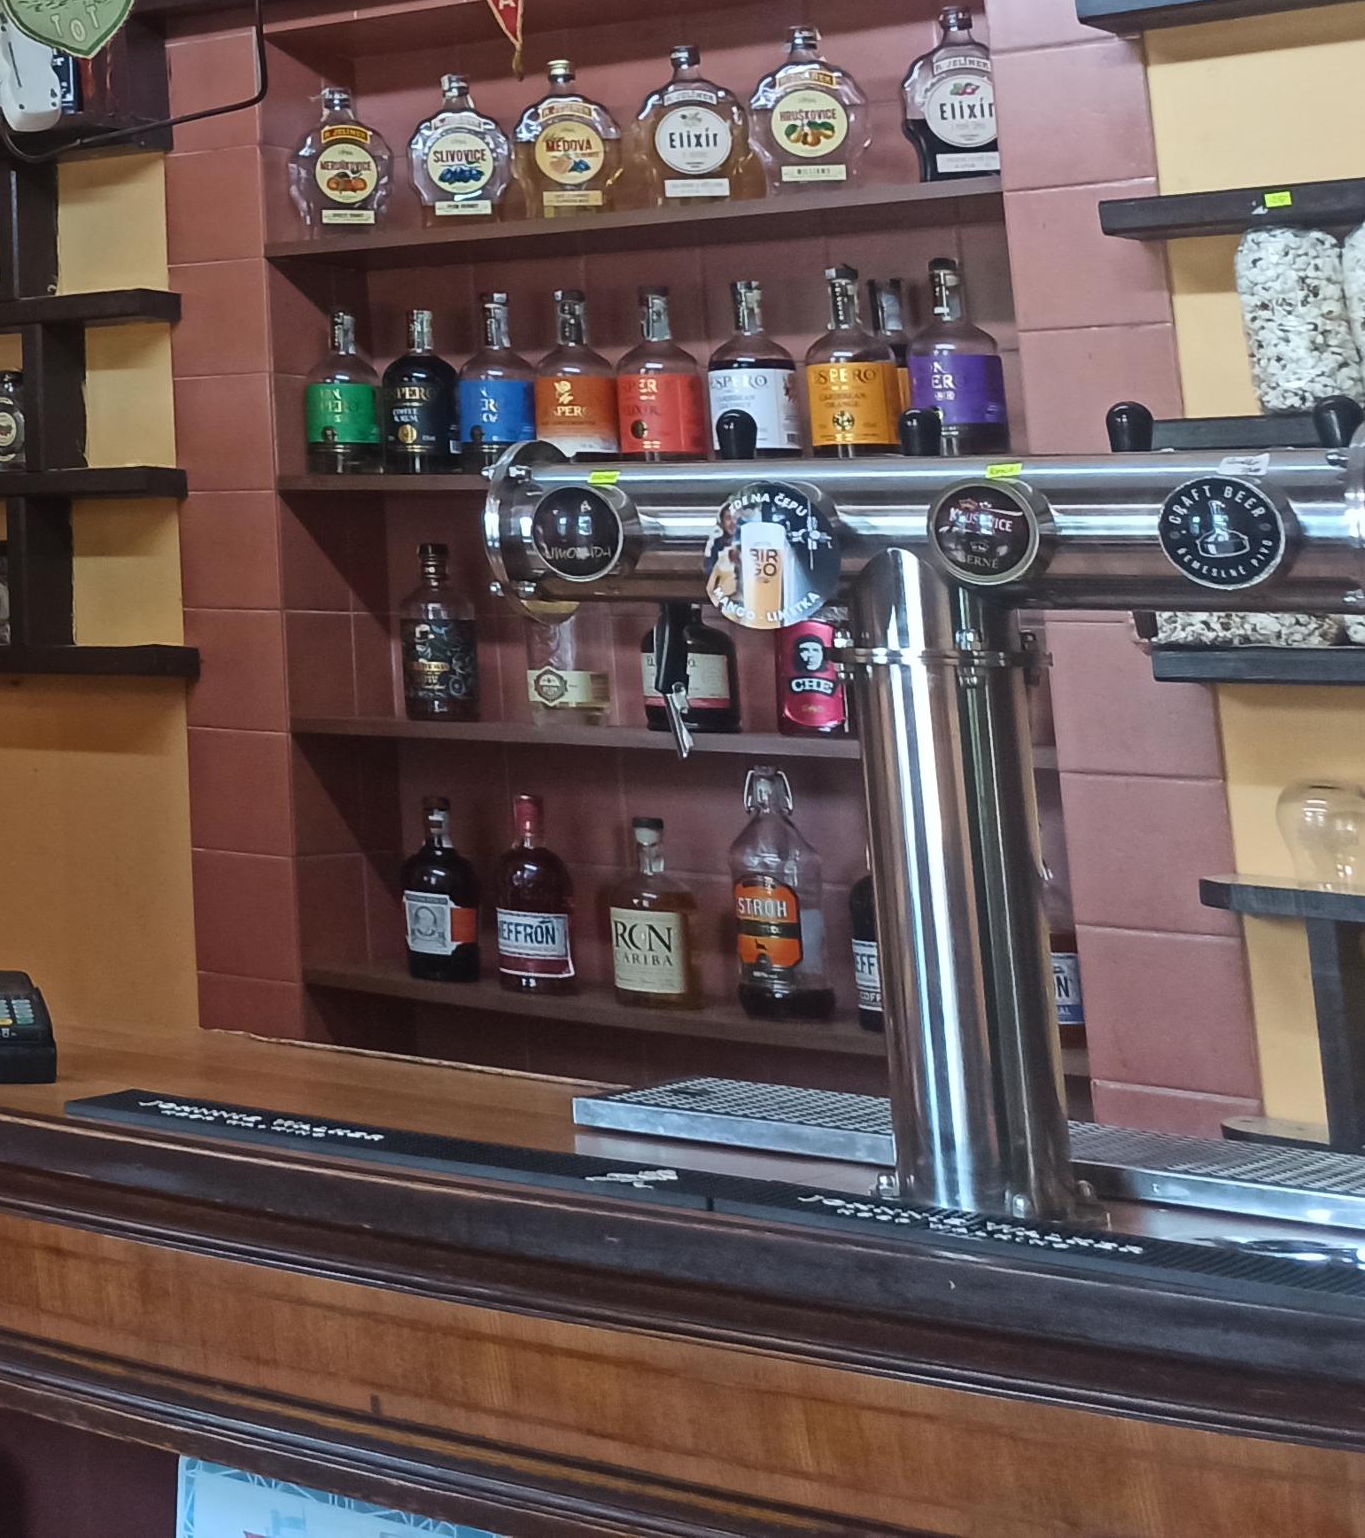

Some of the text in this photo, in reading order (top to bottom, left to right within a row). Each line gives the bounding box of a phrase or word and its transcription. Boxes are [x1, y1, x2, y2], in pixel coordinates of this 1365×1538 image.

[780, 107, 838, 122] HRUŠKOVICE
[938, 97, 995, 121] Elixír
[669, 127, 719, 149] Elixír
[433, 148, 487, 163] SLIVOVICE
[751, 493, 771, 503] NA
[774, 492, 808, 517] ČEPU
[1169, 486, 1266, 524] CRAFT BEER
[750, 548, 778, 563] BIR
[713, 587, 756, 620] MANGO
[791, 678, 835, 694] CHE
[737, 897, 788, 918] STROH
[613, 919, 673, 954] RON
